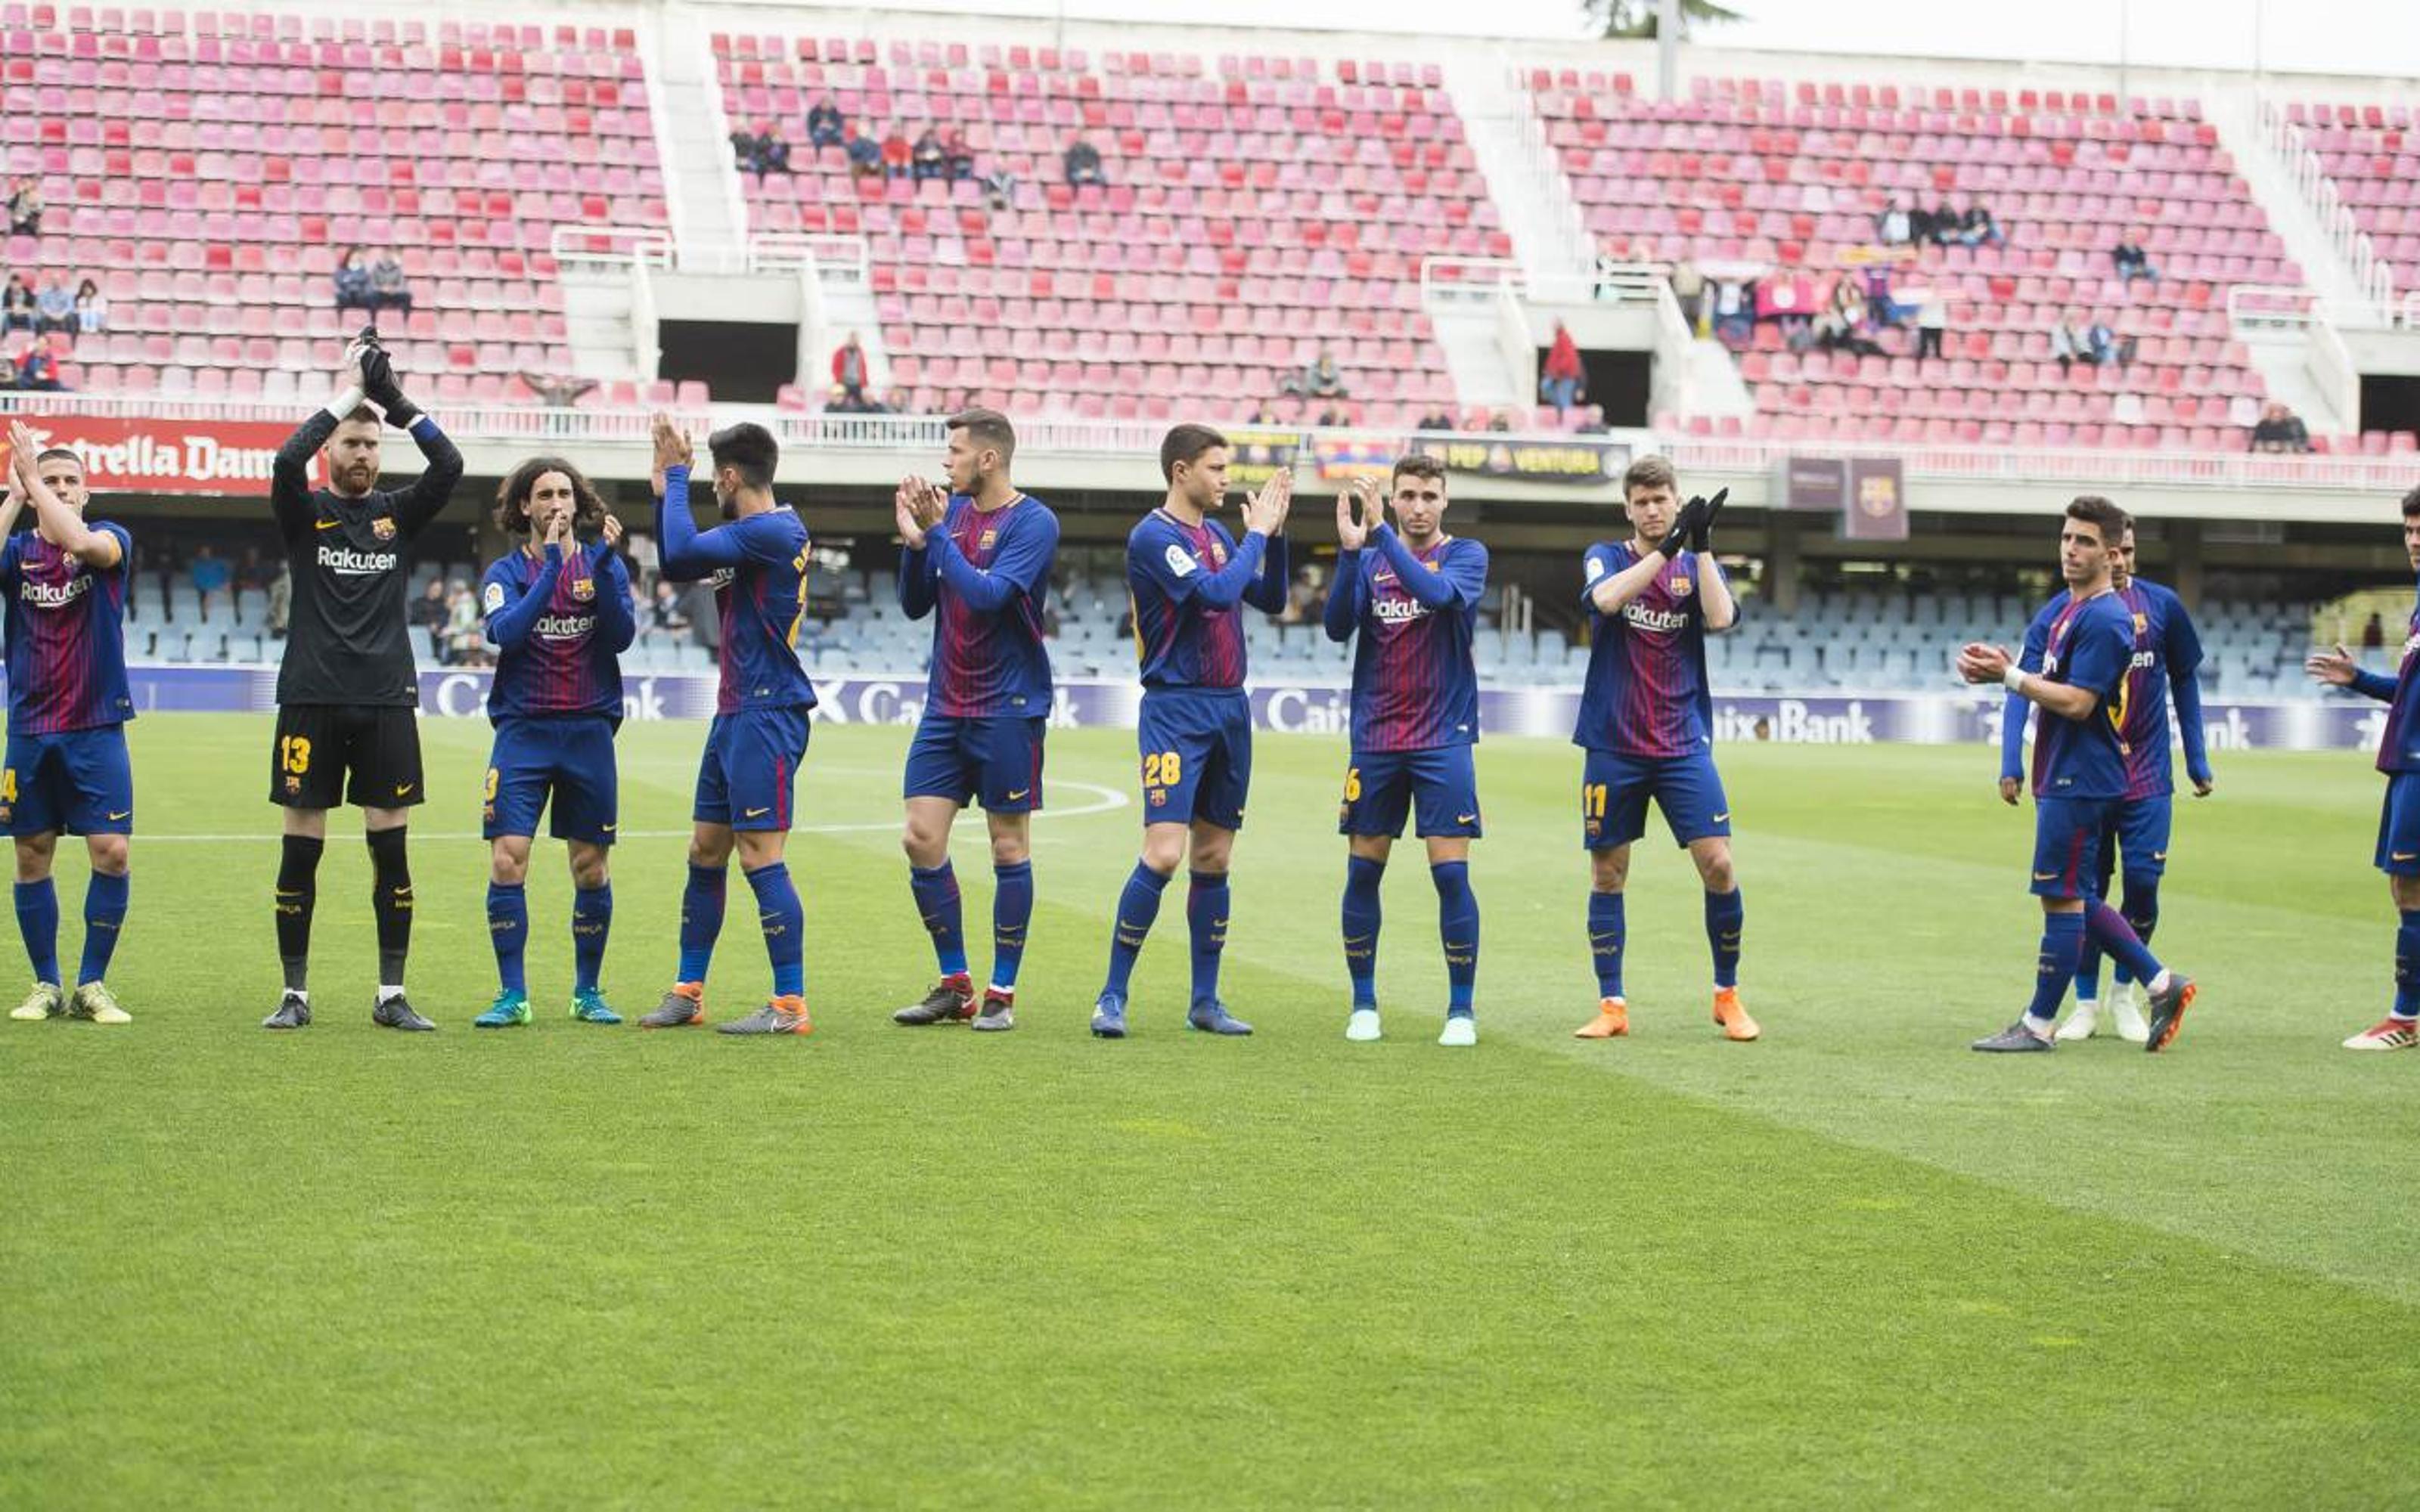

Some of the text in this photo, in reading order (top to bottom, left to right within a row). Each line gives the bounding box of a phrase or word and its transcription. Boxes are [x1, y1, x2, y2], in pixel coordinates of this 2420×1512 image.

[318, 546, 397, 570] Rakuten
[20, 575, 93, 602] Rakuten
[532, 615, 597, 634] akuten
[281, 735, 311, 773] 13
[1145, 751, 1181, 789] 28
[1584, 783, 1606, 817] 11
